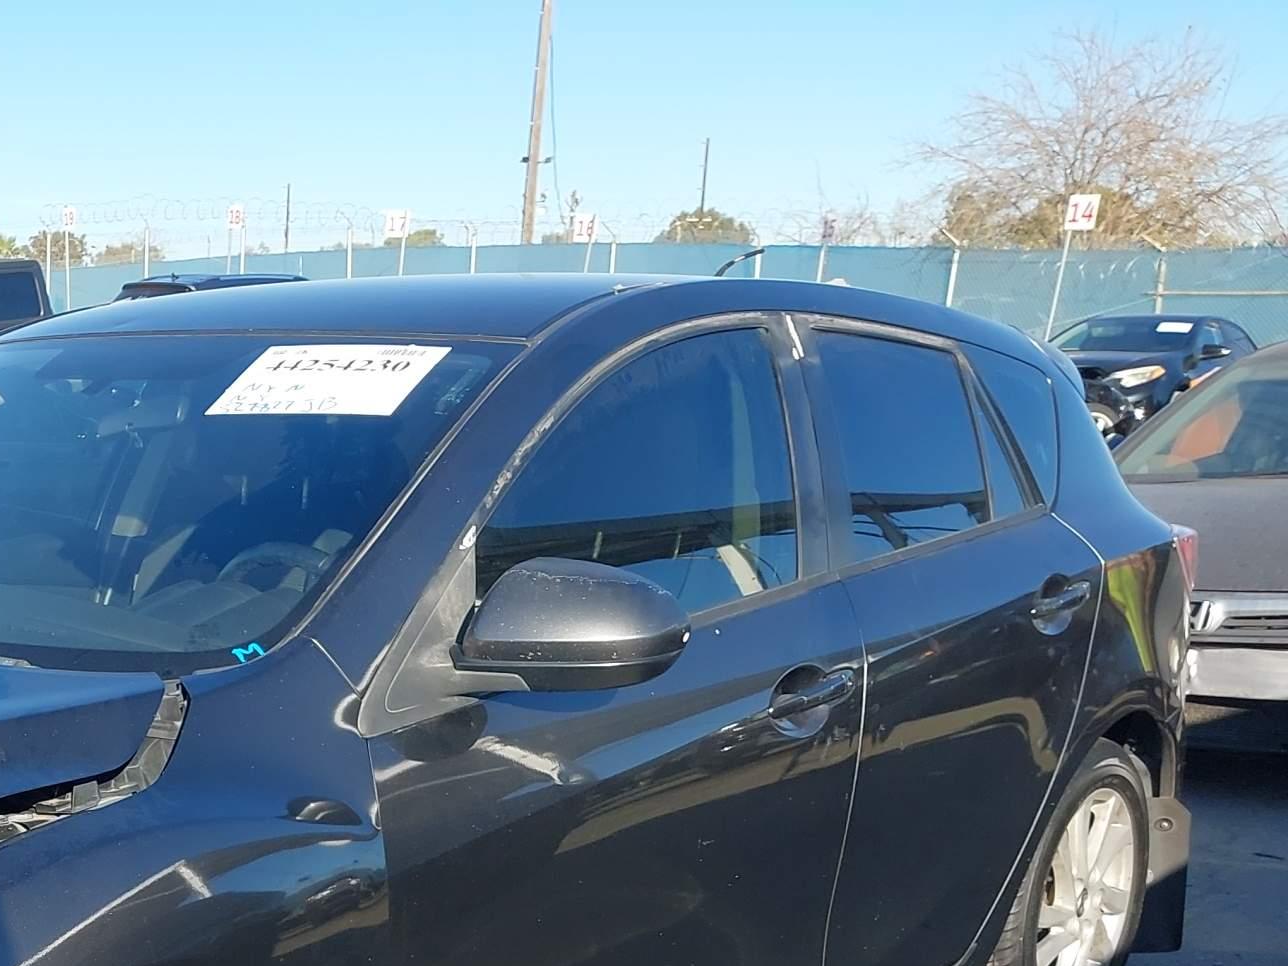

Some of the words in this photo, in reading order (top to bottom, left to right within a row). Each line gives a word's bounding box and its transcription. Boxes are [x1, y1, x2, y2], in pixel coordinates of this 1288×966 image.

[228, 208, 241, 225] 18
[1068, 200, 1094, 223] 14
[388, 216, 407, 232] 17
[265, 359, 411, 371] 44254230
